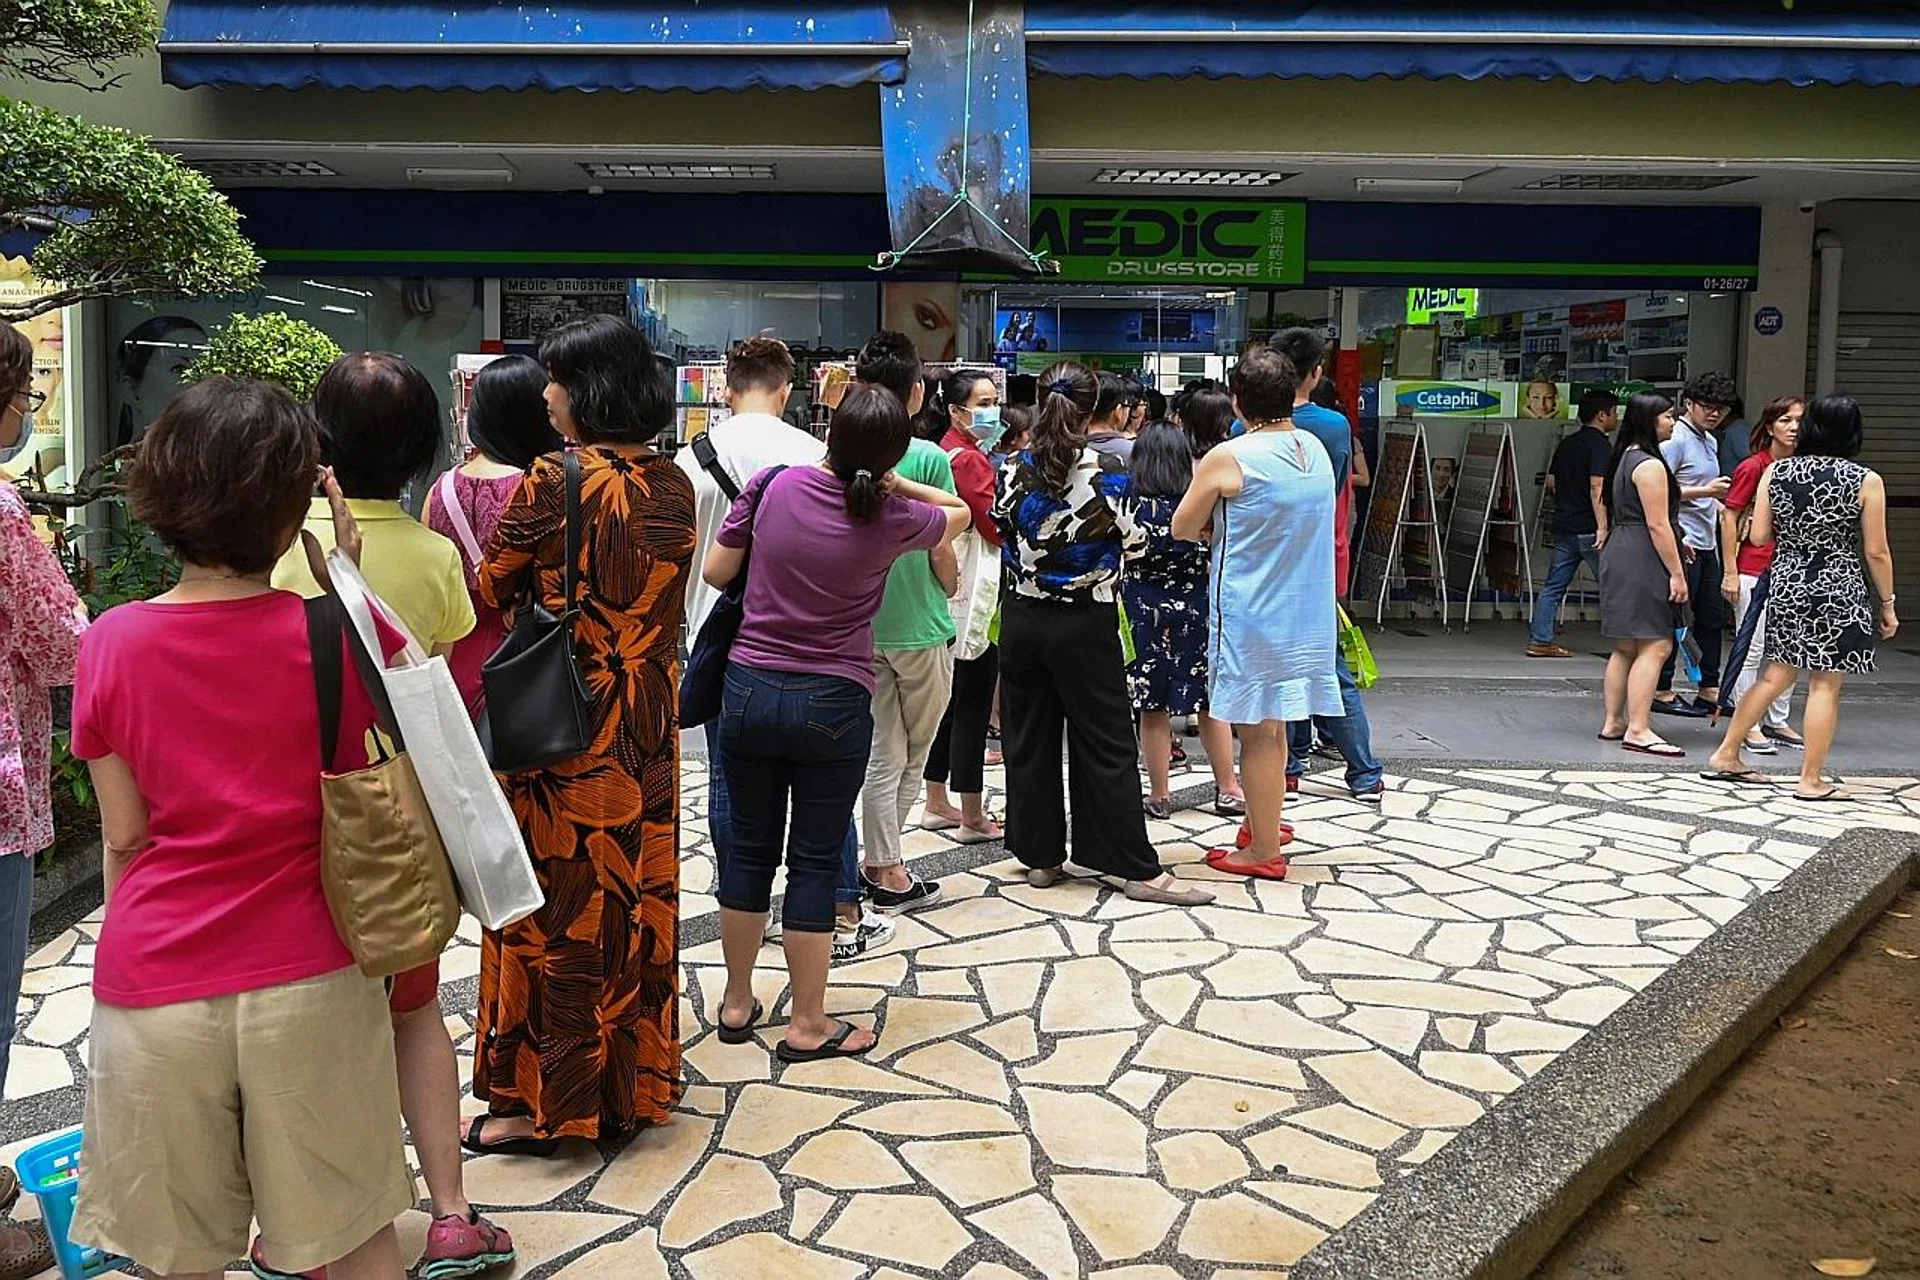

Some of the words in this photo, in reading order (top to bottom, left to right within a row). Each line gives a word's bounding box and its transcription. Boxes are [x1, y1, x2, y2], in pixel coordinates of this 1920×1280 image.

[1107, 261, 1260, 277] DRUGSTORE
[508, 281, 548, 291] MEDIC
[556, 280, 624, 291] DRUGSTORE
[1417, 391, 1479, 409] Cetaphil
